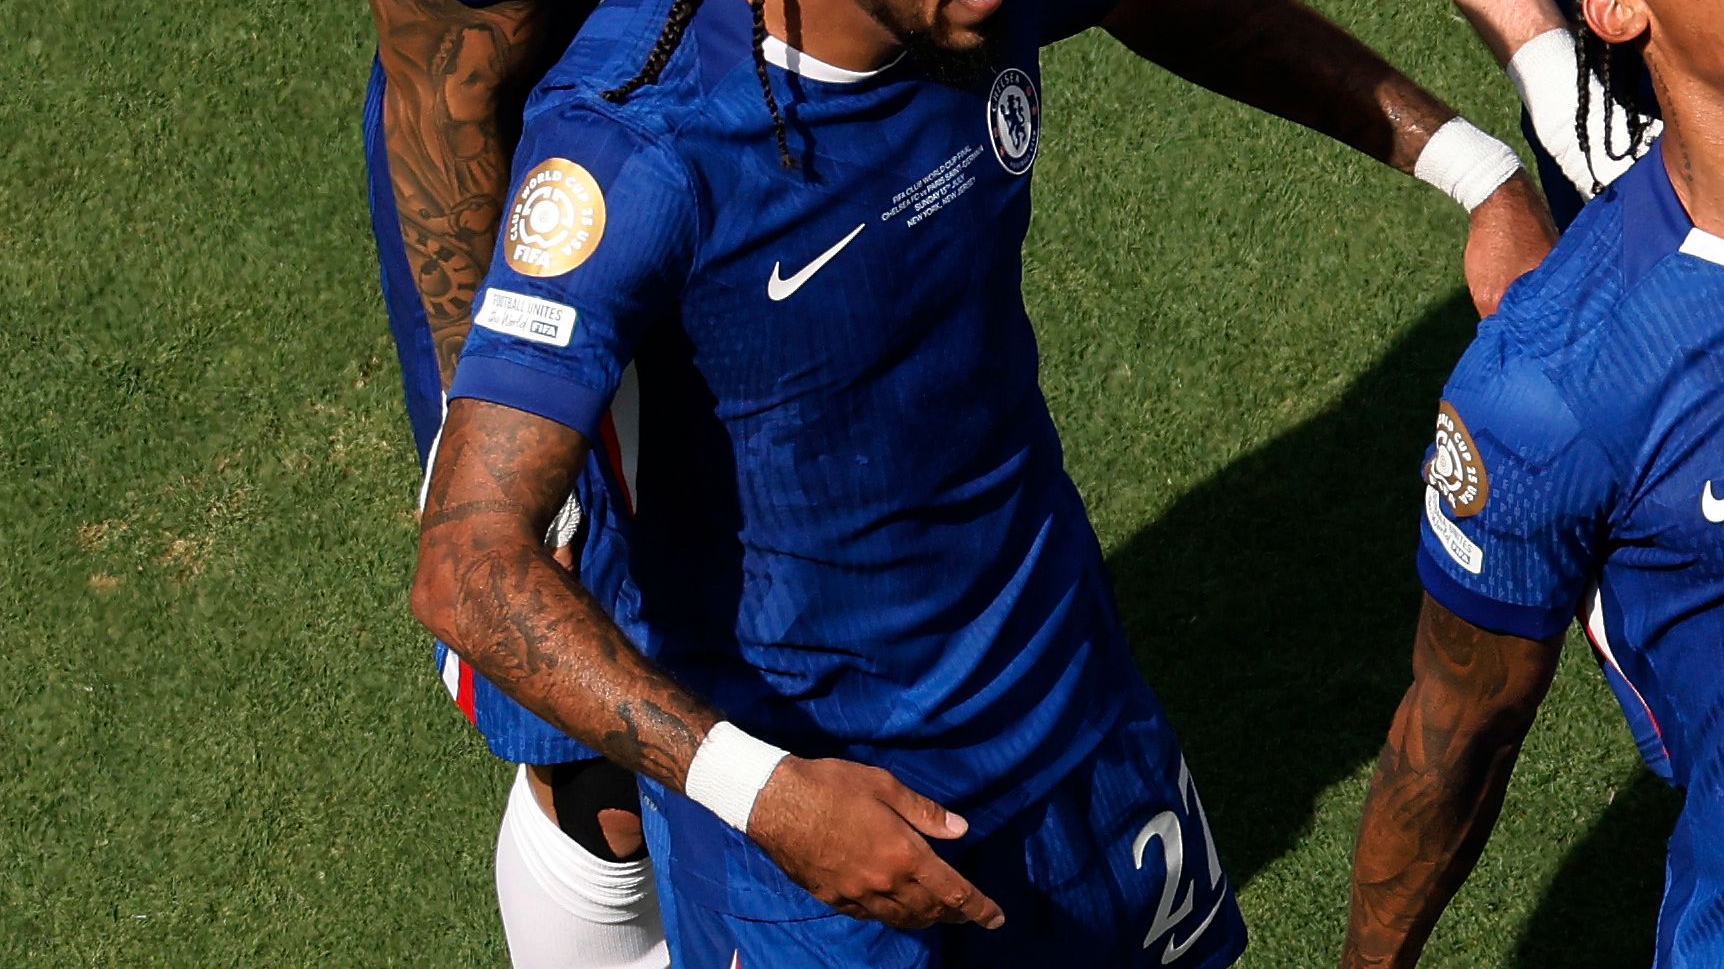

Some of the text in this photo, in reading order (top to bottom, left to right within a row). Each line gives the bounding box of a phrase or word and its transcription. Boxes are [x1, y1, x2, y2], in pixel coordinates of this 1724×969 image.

[510, 204, 523, 241] CLUB
[521, 170, 563, 200] WORLD
[513, 244, 551, 267] FIFA
[527, 302, 563, 321] UNITES
[530, 320, 558, 338] FIFA
[1454, 432, 1471, 462] CUP
[1466, 466, 1478, 484] 25
[1458, 485, 1477, 505] USA
[1132, 751, 1228, 965] 27
